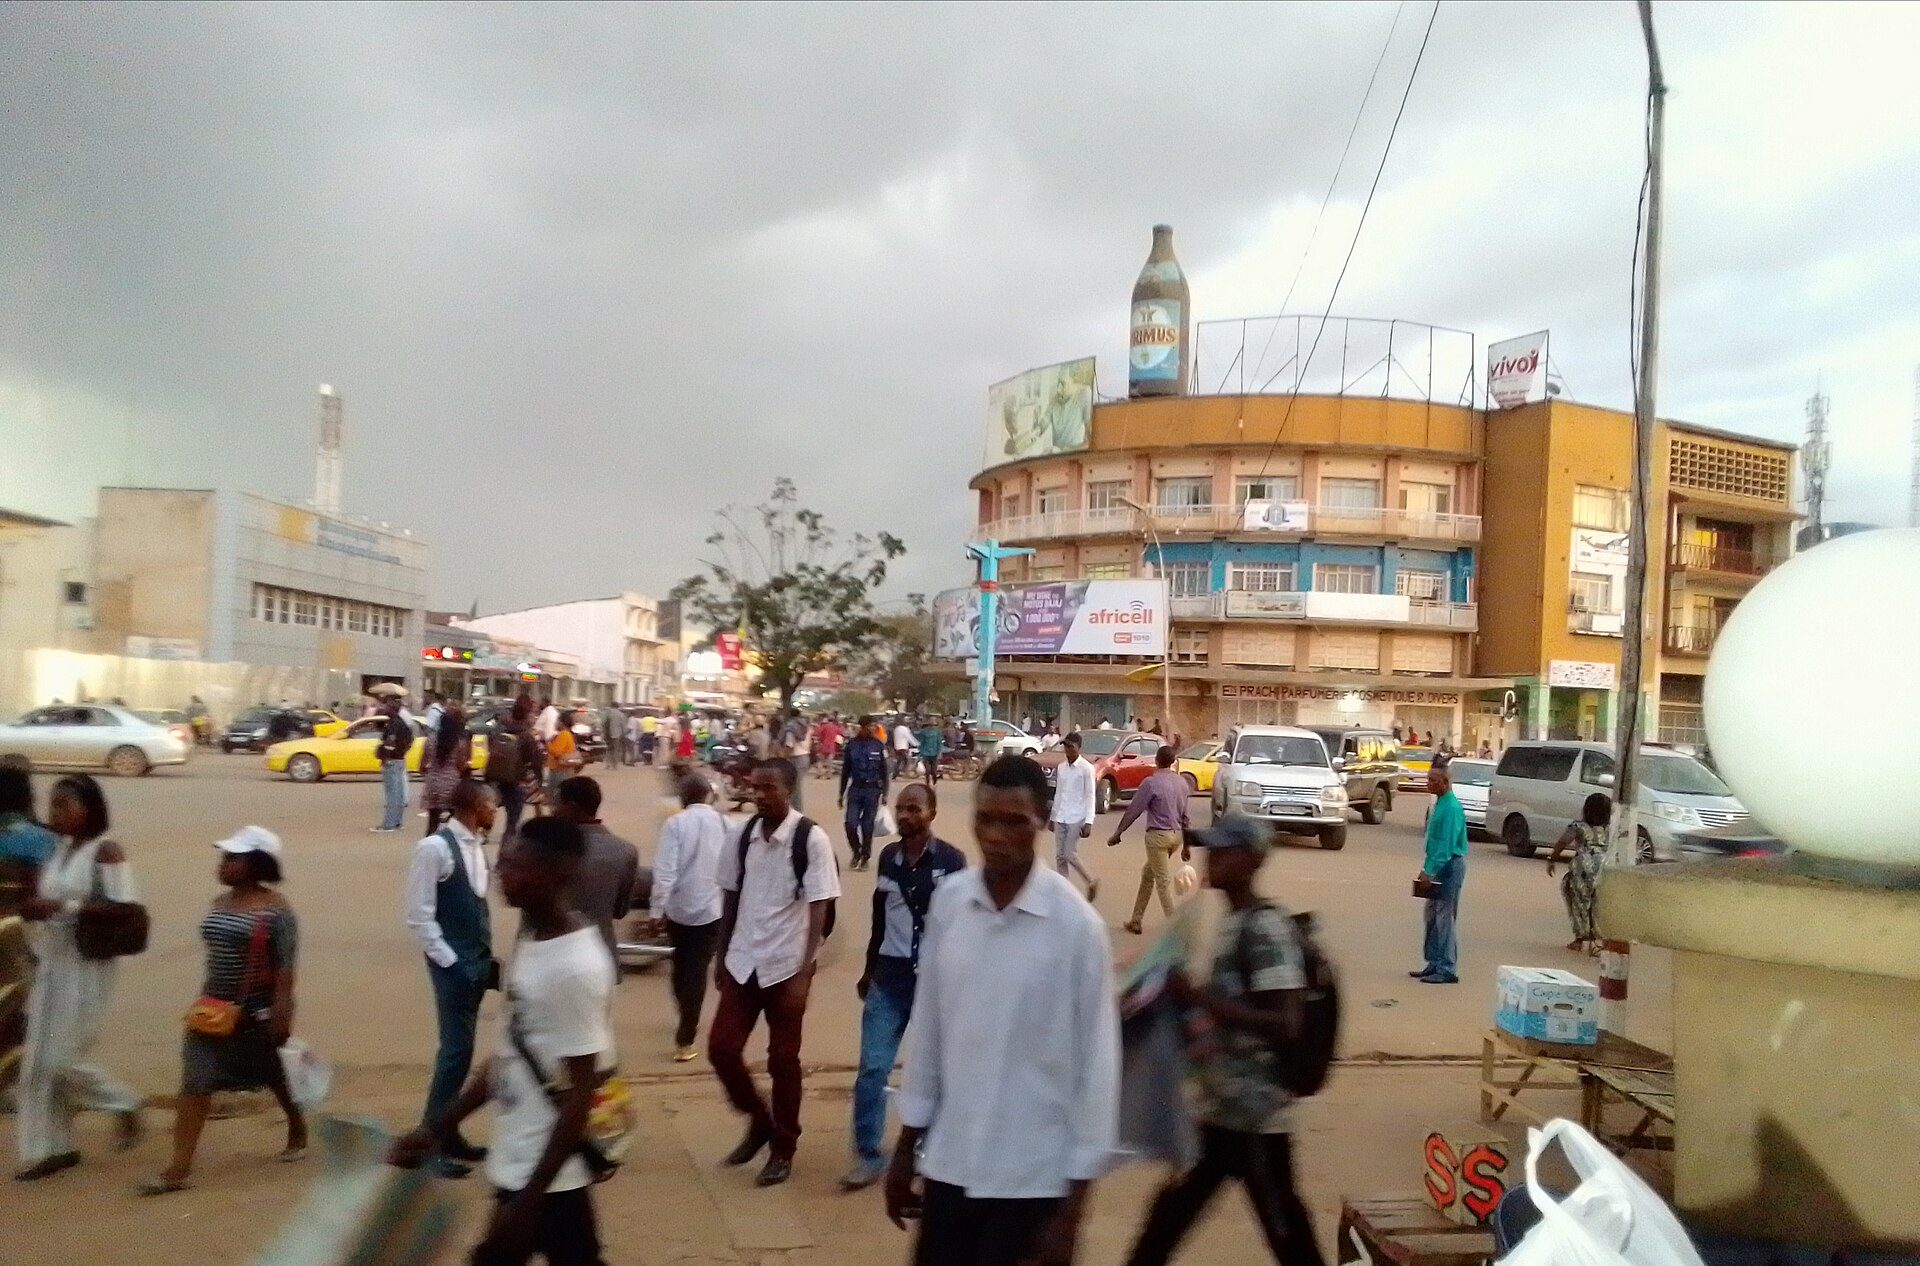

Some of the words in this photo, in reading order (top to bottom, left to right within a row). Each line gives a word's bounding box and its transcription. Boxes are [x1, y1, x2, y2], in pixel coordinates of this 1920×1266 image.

[1132, 327, 1177, 346] RIMUS
[1088, 608, 1153, 624] africell
[1281, 686, 1350, 700] PARFUMERIE
